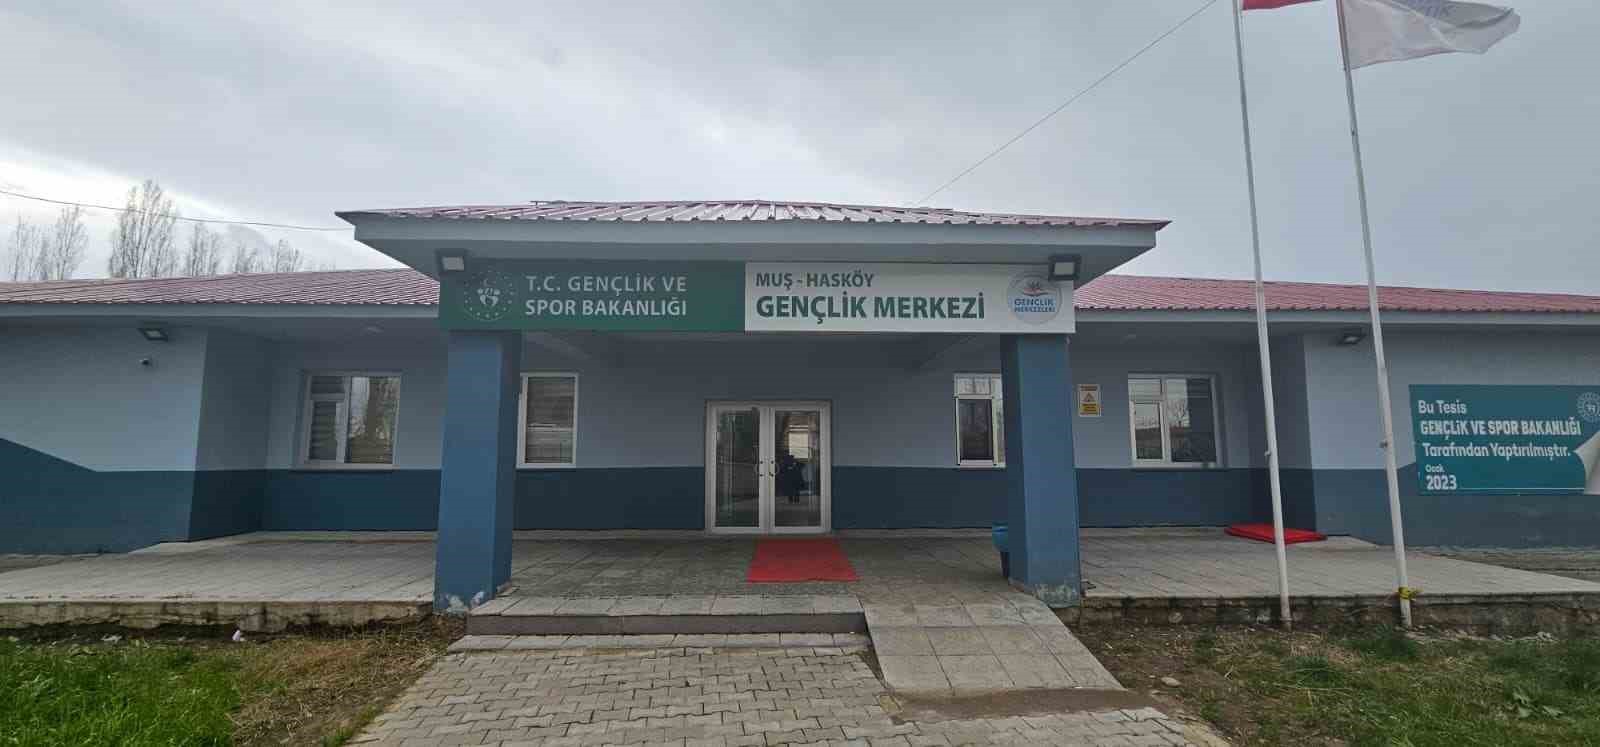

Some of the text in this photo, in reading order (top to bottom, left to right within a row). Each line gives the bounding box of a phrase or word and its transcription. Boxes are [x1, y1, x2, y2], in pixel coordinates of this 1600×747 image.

[525, 273, 687, 297] T.C. GENÇLİK VE
[756, 272, 793, 291] MUŞ
[806, 269, 875, 288] HASKÖY
[525, 296, 687, 316] SPOR BAKANLIĞI
[756, 291, 985, 324] GENÇLİK MERKEZİ
[1418, 399, 1467, 414] Bu Tesis
[1471, 420, 1486, 435] VE
[1487, 420, 1518, 435] SPOR
[1521, 416, 1581, 436] BAKANLIĞI
[1422, 442, 1571, 461] Tarafından Yaptırılmıştır.
[1425, 475, 1457, 490] 2023
